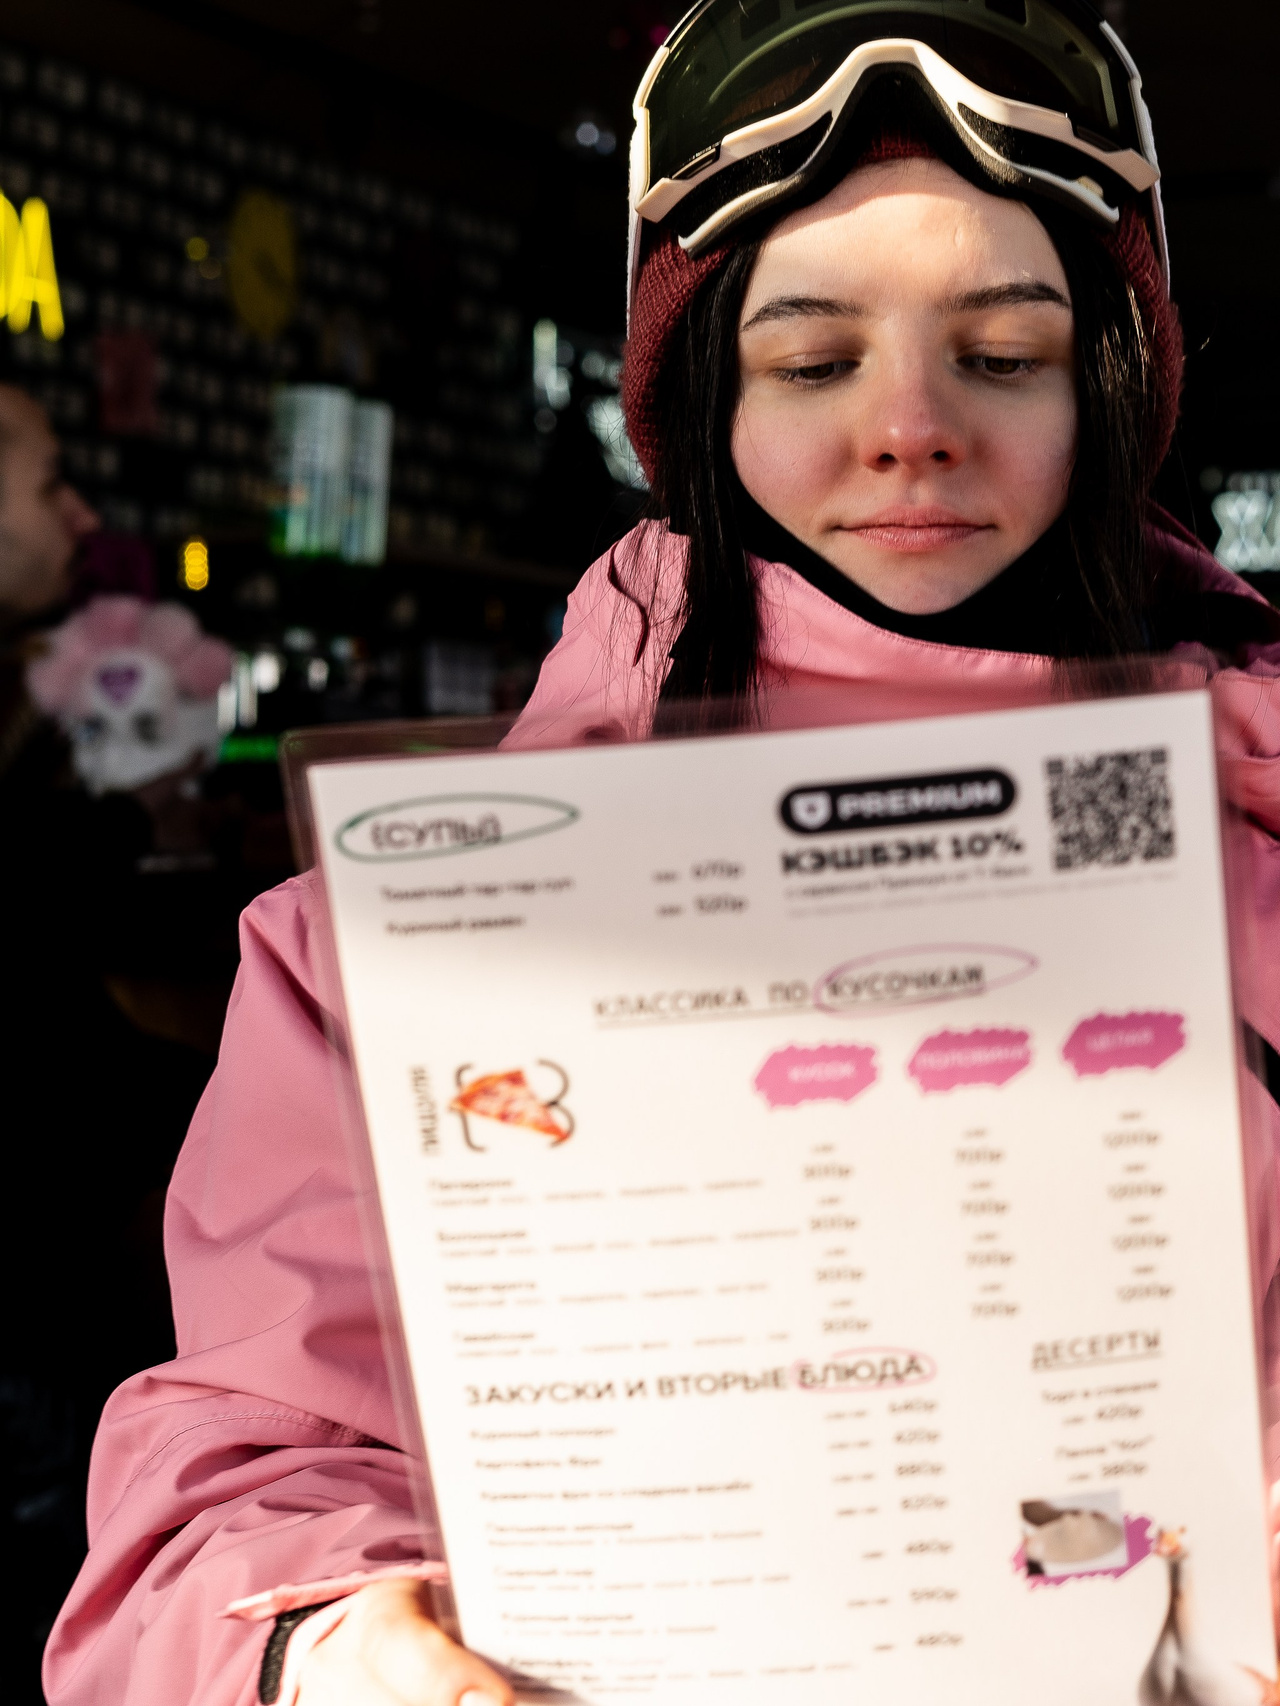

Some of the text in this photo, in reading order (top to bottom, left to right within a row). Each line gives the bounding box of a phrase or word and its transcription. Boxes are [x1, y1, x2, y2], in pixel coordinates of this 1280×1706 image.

[836, 779, 1002, 821] PREMIUM
[781, 826, 1024, 875] КЭШБЭК 10%
[594, 965, 985, 1019] КЛАССИКА ПО КУСОЧКАМ
[1032, 1329, 1162, 1370] ДЕСЕРТЫ
[465, 1355, 925, 1406] ЗАКУСКИ И ВТОРЫЕ БЛЮДА
